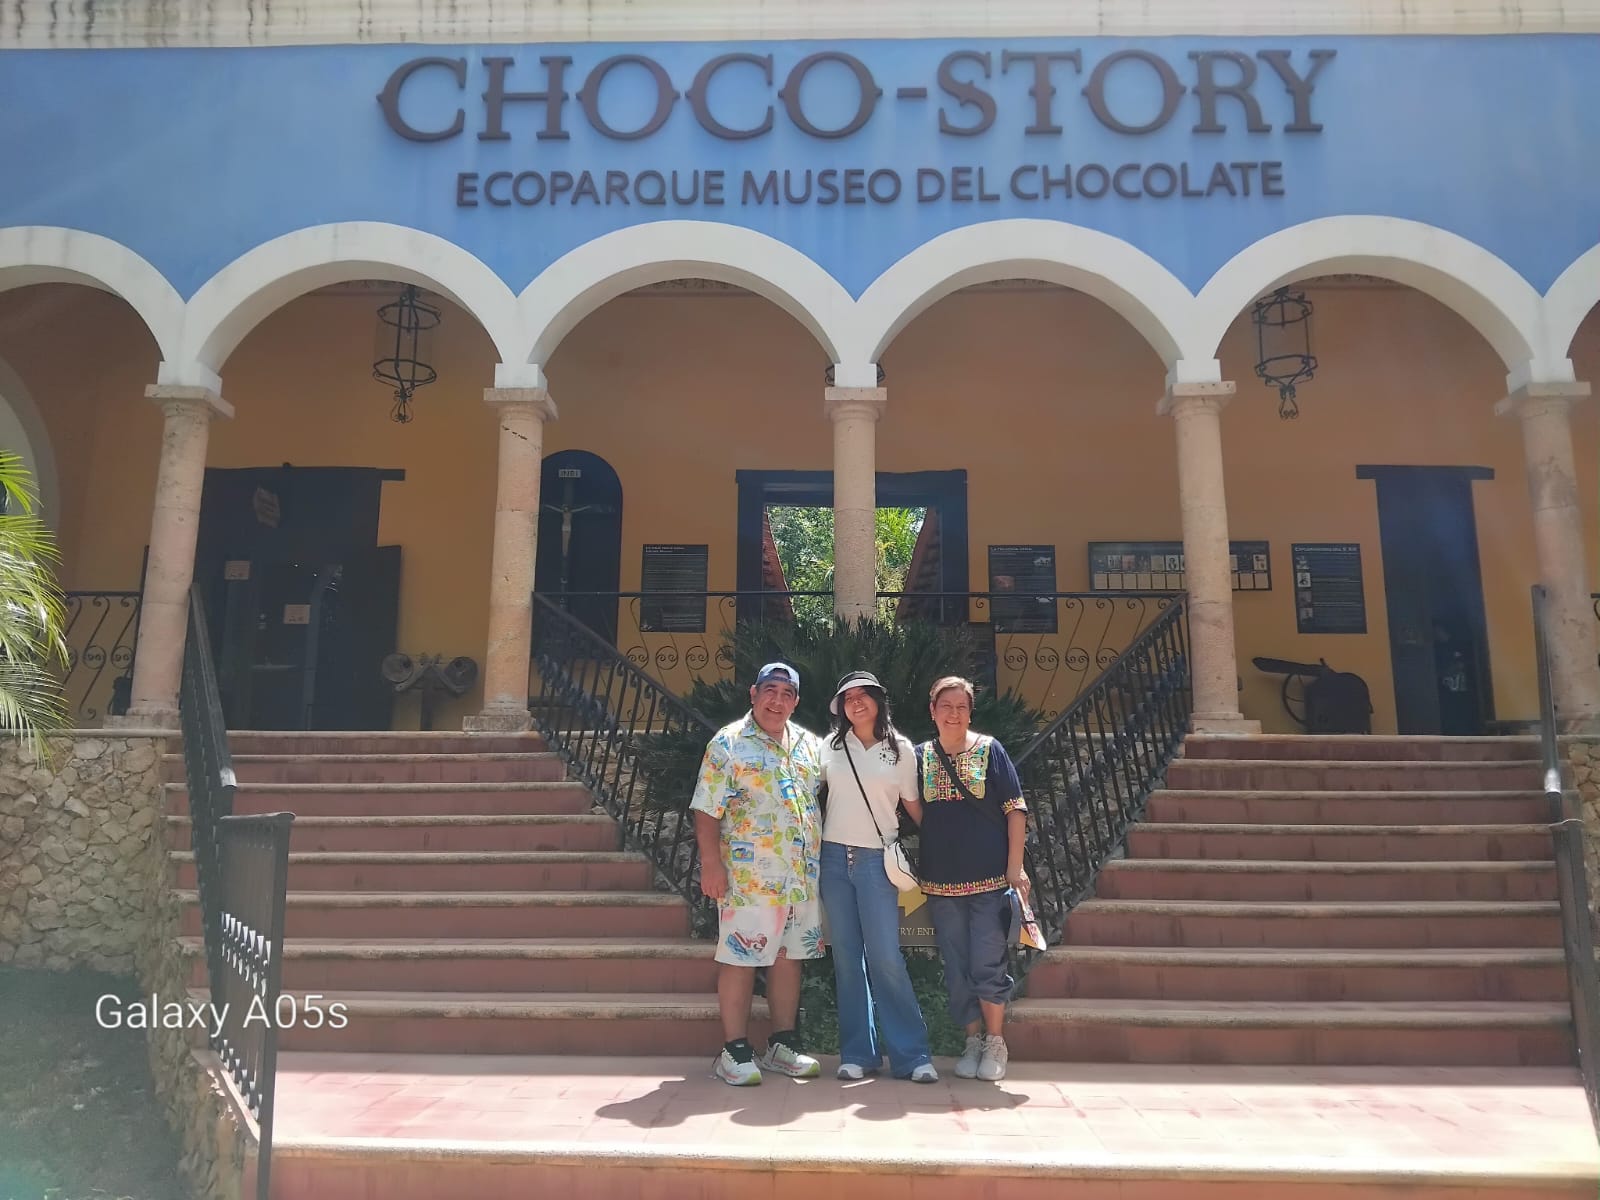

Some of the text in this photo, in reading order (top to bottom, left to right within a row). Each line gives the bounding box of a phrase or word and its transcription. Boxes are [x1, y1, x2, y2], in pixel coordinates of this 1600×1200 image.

[376, 49, 1337, 143] CHOCO-STORY
[457, 161, 1285, 207] ECOPARQUE MUSEO DEL CHOCOLATE
[898, 927, 915, 936] RY/
